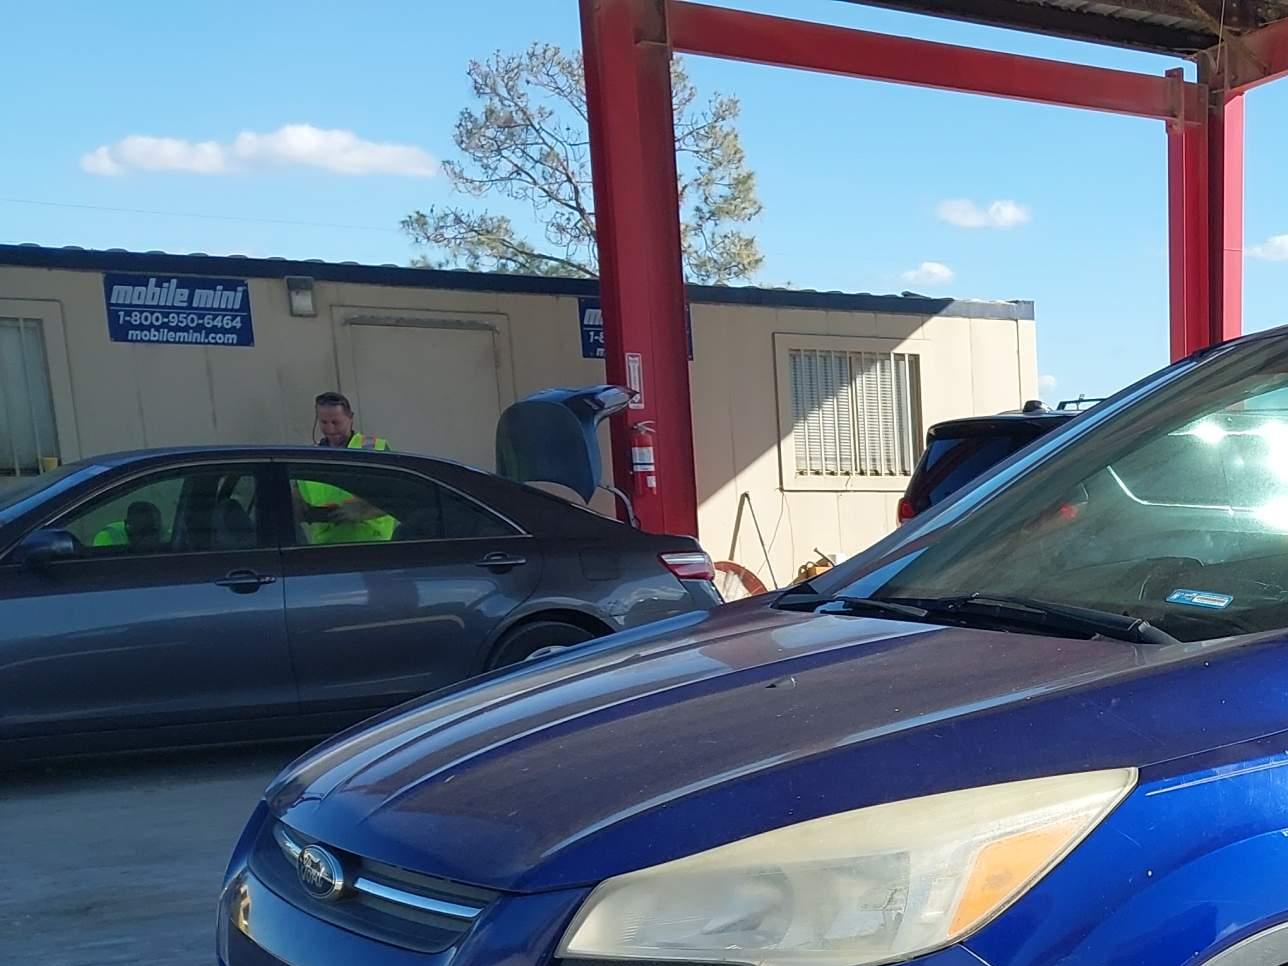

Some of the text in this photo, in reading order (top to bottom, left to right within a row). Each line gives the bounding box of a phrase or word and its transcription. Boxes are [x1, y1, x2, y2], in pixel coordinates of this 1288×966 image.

[110, 278, 244, 309] mobile mini
[118, 311, 242, 329] 1-800-950-6464
[128, 328, 238, 344] mobilemini.com
